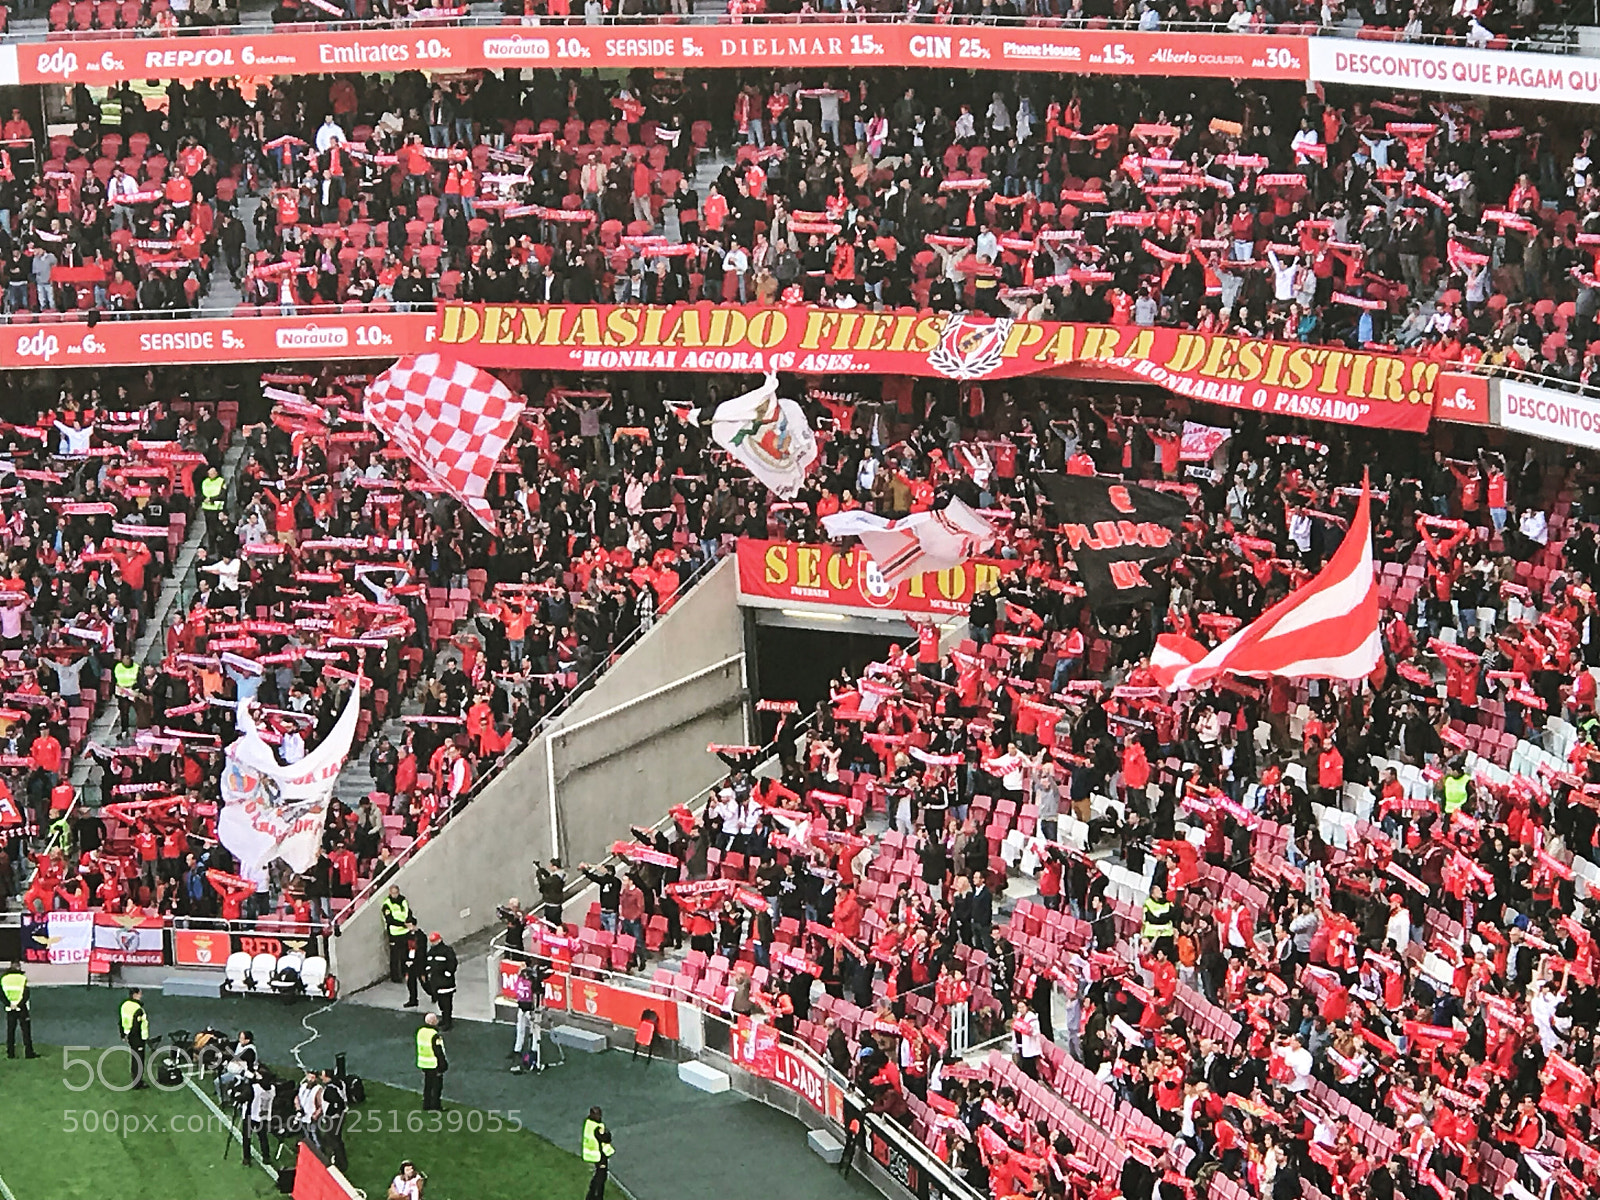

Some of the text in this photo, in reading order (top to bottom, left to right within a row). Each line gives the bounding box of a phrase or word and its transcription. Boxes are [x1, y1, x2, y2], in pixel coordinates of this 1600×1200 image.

[319, 39, 452, 63] Emirates 10%
[489, 38, 591, 58] Norauto 10%
[605, 37, 704, 57] SEASIDE 5%
[721, 35, 884, 56] DIELMAR 15%
[909, 35, 991, 59] CIN 25%
[1102, 44, 1134, 65] 15%
[37, 47, 78, 77] edp
[101, 52, 124, 71] 6%
[145, 49, 235, 68] REPSOL
[241, 46, 255, 65] 6
[1149, 48, 1197, 64] Alberto
[1199, 55, 1244, 65] OCULISTA
[1266, 48, 1300, 69] 30%
[1336, 52, 1600, 93] DESCONTOS QUE PAGAM QU
[17, 330, 59, 361] edp
[82, 334, 106, 354] 6%
[140, 330, 245, 351] SEASIDE 5%
[282, 326, 392, 345] Norauto 10%
[440, 306, 1439, 405] DEMASIADO FIEIS PARA DESISTIR!!
[681, 351, 763, 370] AGORA
[799, 353, 870, 371] ASES...
[1133, 359, 1244, 404] HONRARAM
[1252, 391, 1267, 409] O
[1455, 388, 1476, 411] 6%
[1507, 394, 1600, 434] DESCONTOS
[34, 912, 92, 924] CARREGA
[26, 949, 90, 963] BENFICA
[240, 936, 282, 959] RED
